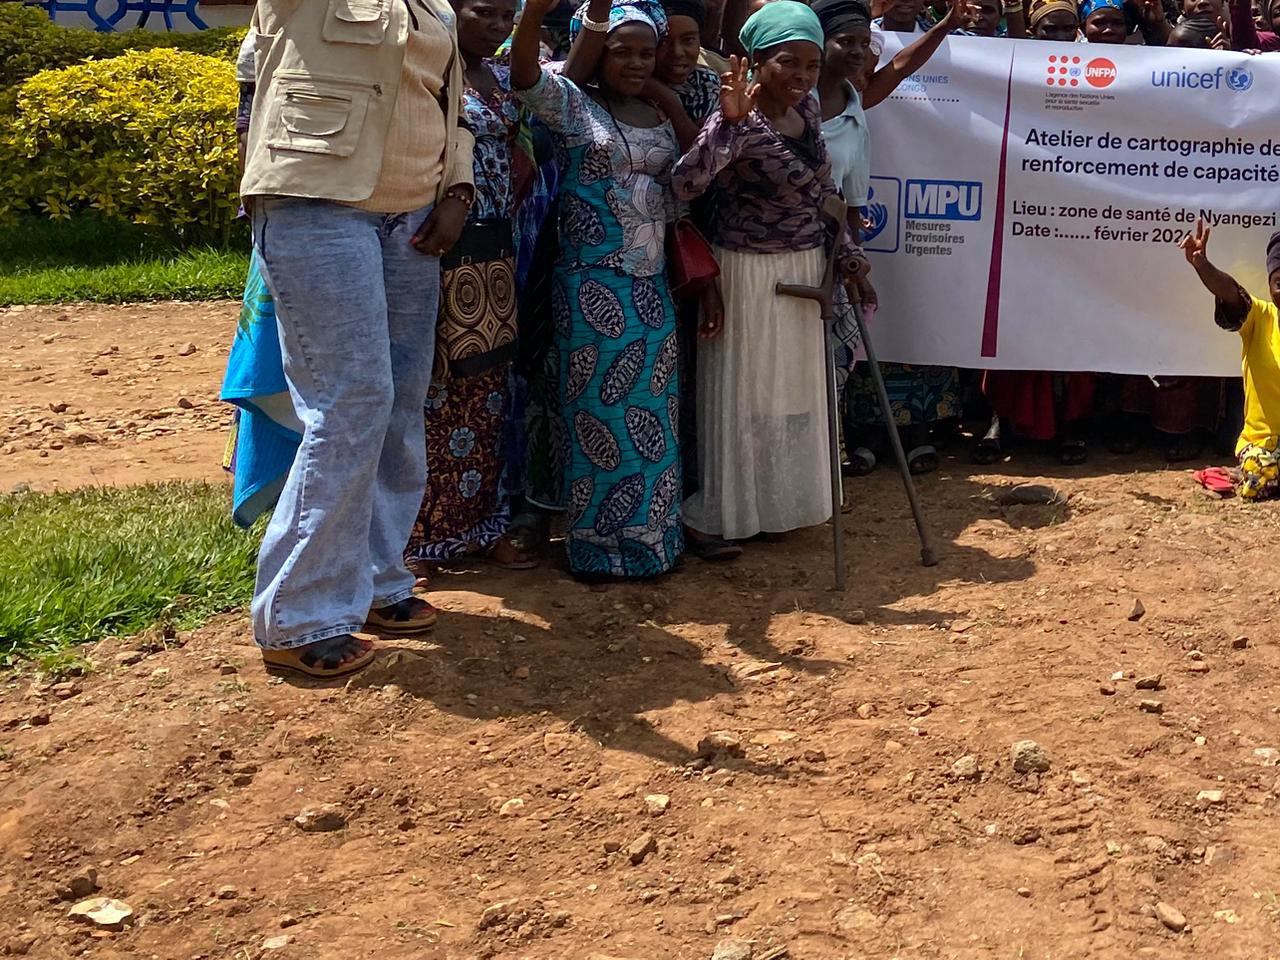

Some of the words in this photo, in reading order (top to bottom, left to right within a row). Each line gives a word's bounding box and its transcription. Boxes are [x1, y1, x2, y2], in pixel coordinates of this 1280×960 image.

[922, 76, 948, 84] UNIES
[1086, 67, 1116, 78] UNFPA
[1151, 66, 1224, 90] unicef
[1025, 128, 1093, 148] Atelier
[1097, 132, 1122, 149] de
[1127, 135, 1255, 157] cartographie
[1022, 156, 1159, 177] renforcement
[1164, 161, 1188, 178] de
[907, 183, 980, 216] MPU
[1013, 201, 1046, 216] Lieu
[1059, 207, 1098, 218] zone
[1102, 205, 1122, 220] de
[1126, 207, 1170, 222] santé
[1175, 208, 1195, 223] de
[1200, 209, 1276, 228] Nyangezi
[906, 221, 951, 231] Mesures
[1012, 222, 1050, 237] Date
[1094, 226, 1148, 241] février
[905, 232, 964, 243] Provisoires
[905, 244, 952, 256] Urgentes
